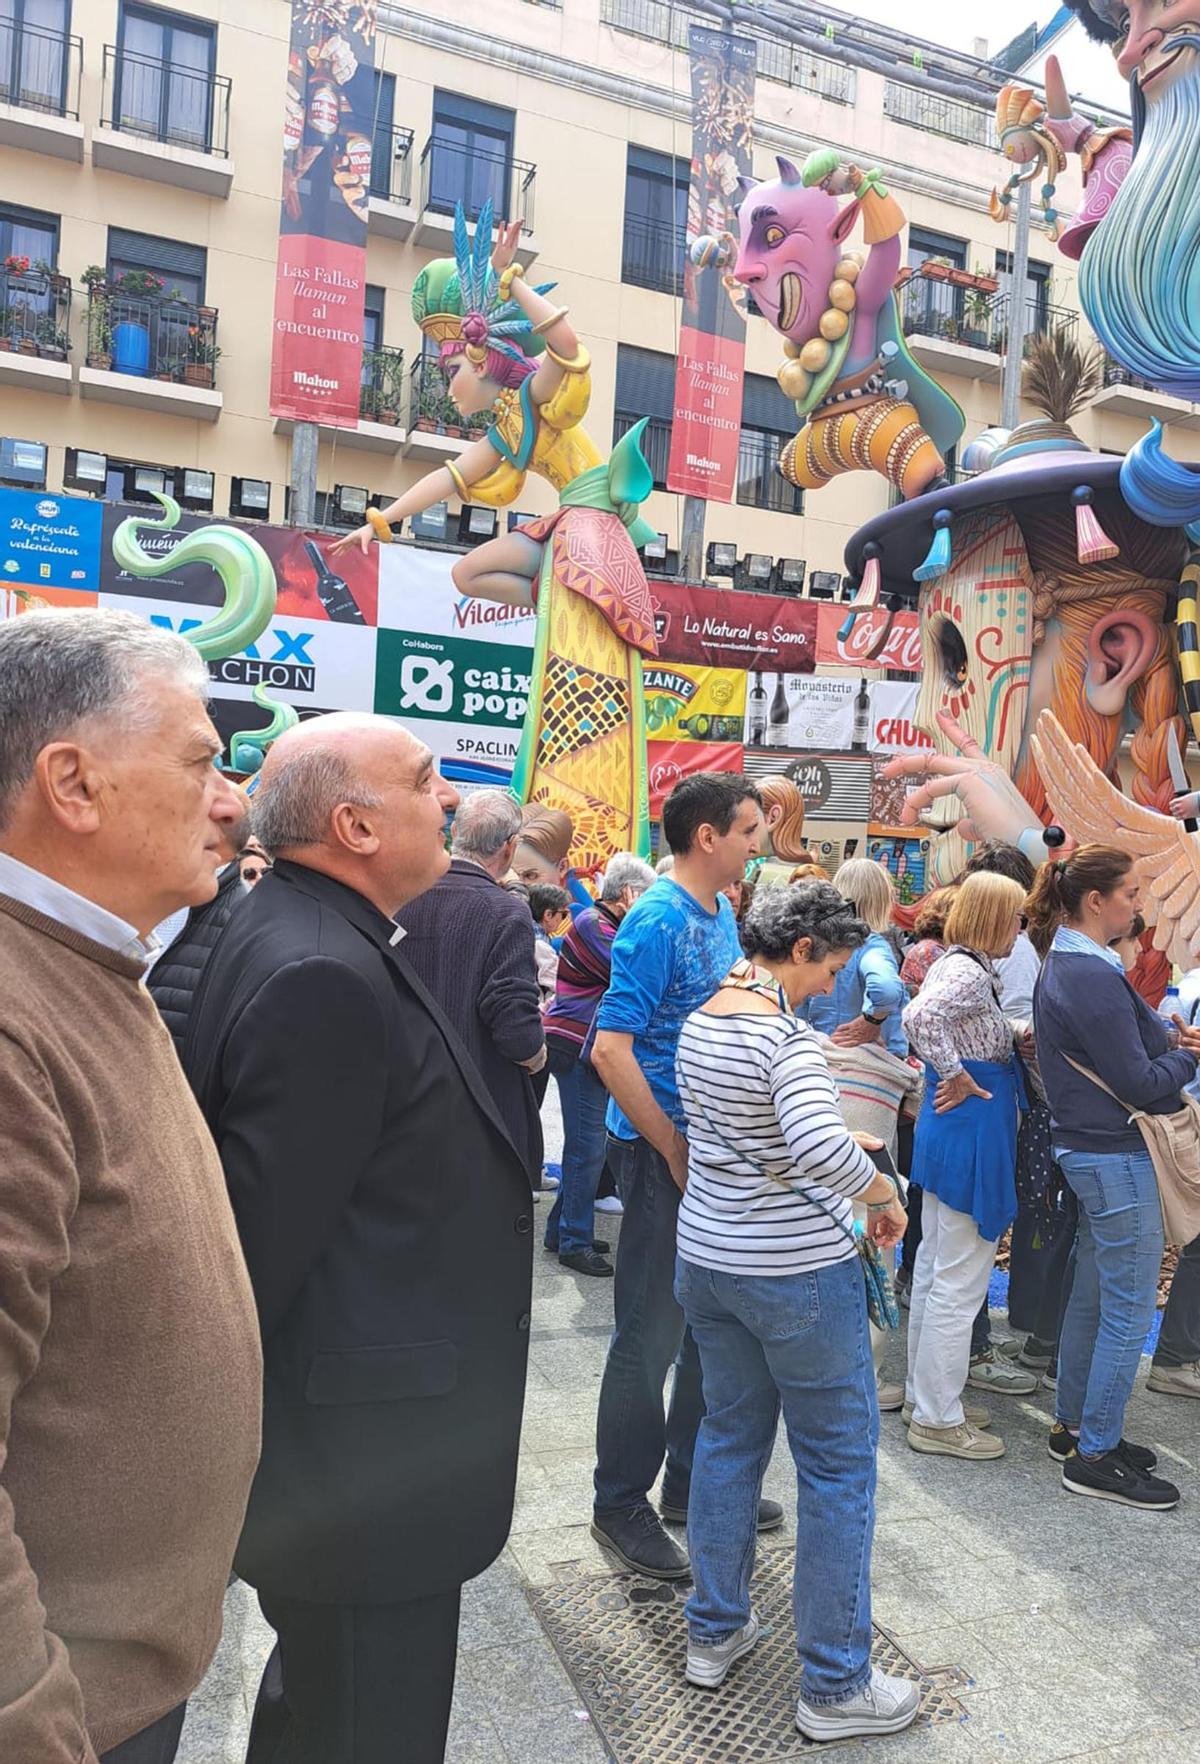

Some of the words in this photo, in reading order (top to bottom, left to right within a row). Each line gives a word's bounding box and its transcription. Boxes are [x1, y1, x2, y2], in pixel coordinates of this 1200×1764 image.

[283, 262, 310, 278] Las
[314, 266, 360, 290] Fallas
[292, 281, 347, 305] llaman
[312, 304, 327, 319] al
[277, 319, 360, 344] encuentro
[293, 371, 339, 390] Mahou
[683, 355, 703, 372] Las
[706, 361, 739, 382] Fallas
[690, 373, 730, 396] llaman
[703, 395, 715, 410] al
[676, 407, 738, 432] encuentro
[686, 454, 721, 471] Mahou
[9, 538, 79, 556] valenciana
[683, 615, 699, 634] Lo
[702, 617, 752, 640] Natural
[755, 629, 769, 642] es
[771, 625, 809, 646] Sano.
[643, 671, 693, 698] ZANTE
